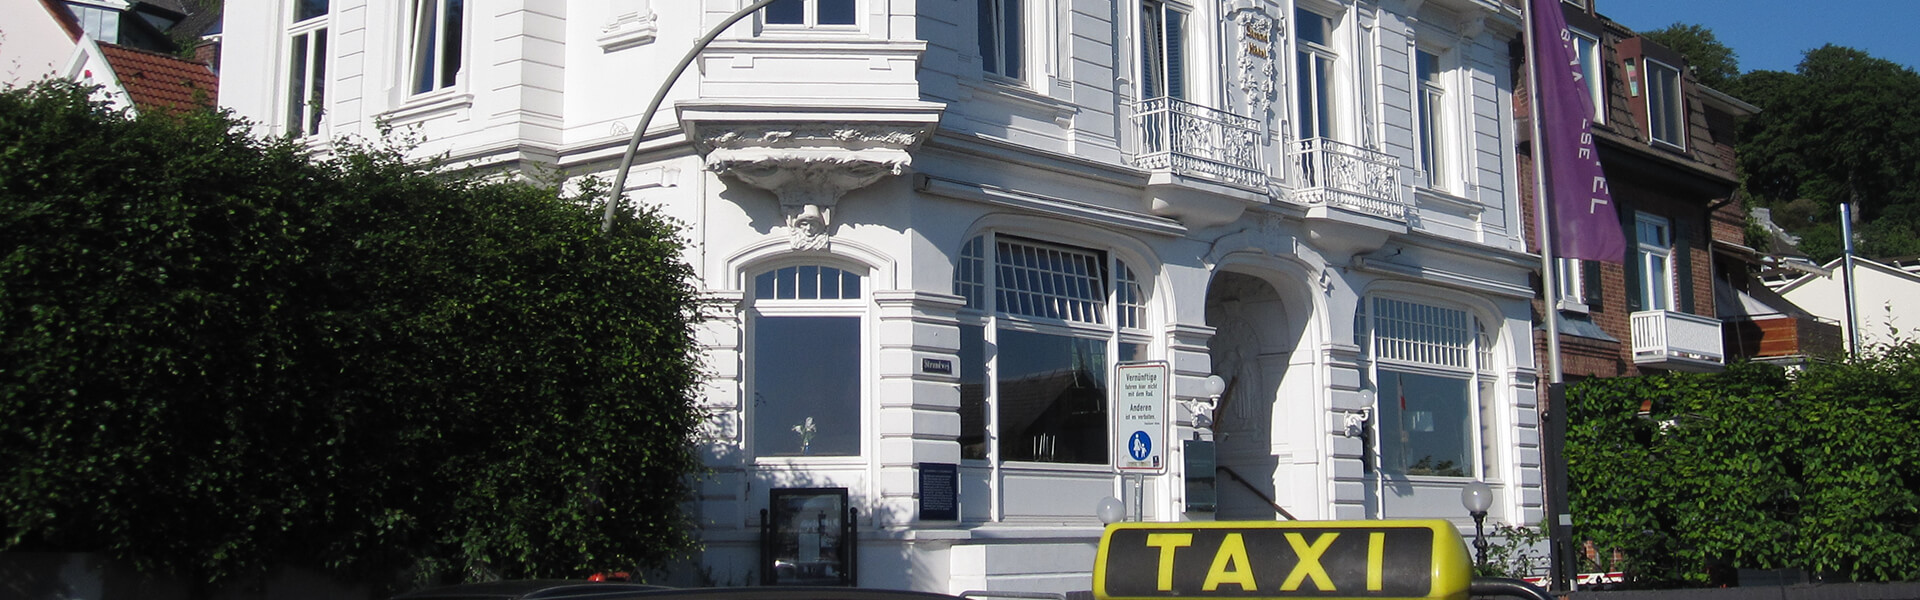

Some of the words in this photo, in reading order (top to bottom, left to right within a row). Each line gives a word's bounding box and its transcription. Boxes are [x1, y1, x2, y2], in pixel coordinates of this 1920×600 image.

[1126, 373, 1157, 383] Vernünftige
[1129, 403, 1152, 412] Anderen
[1146, 532, 1386, 592] TAXI
